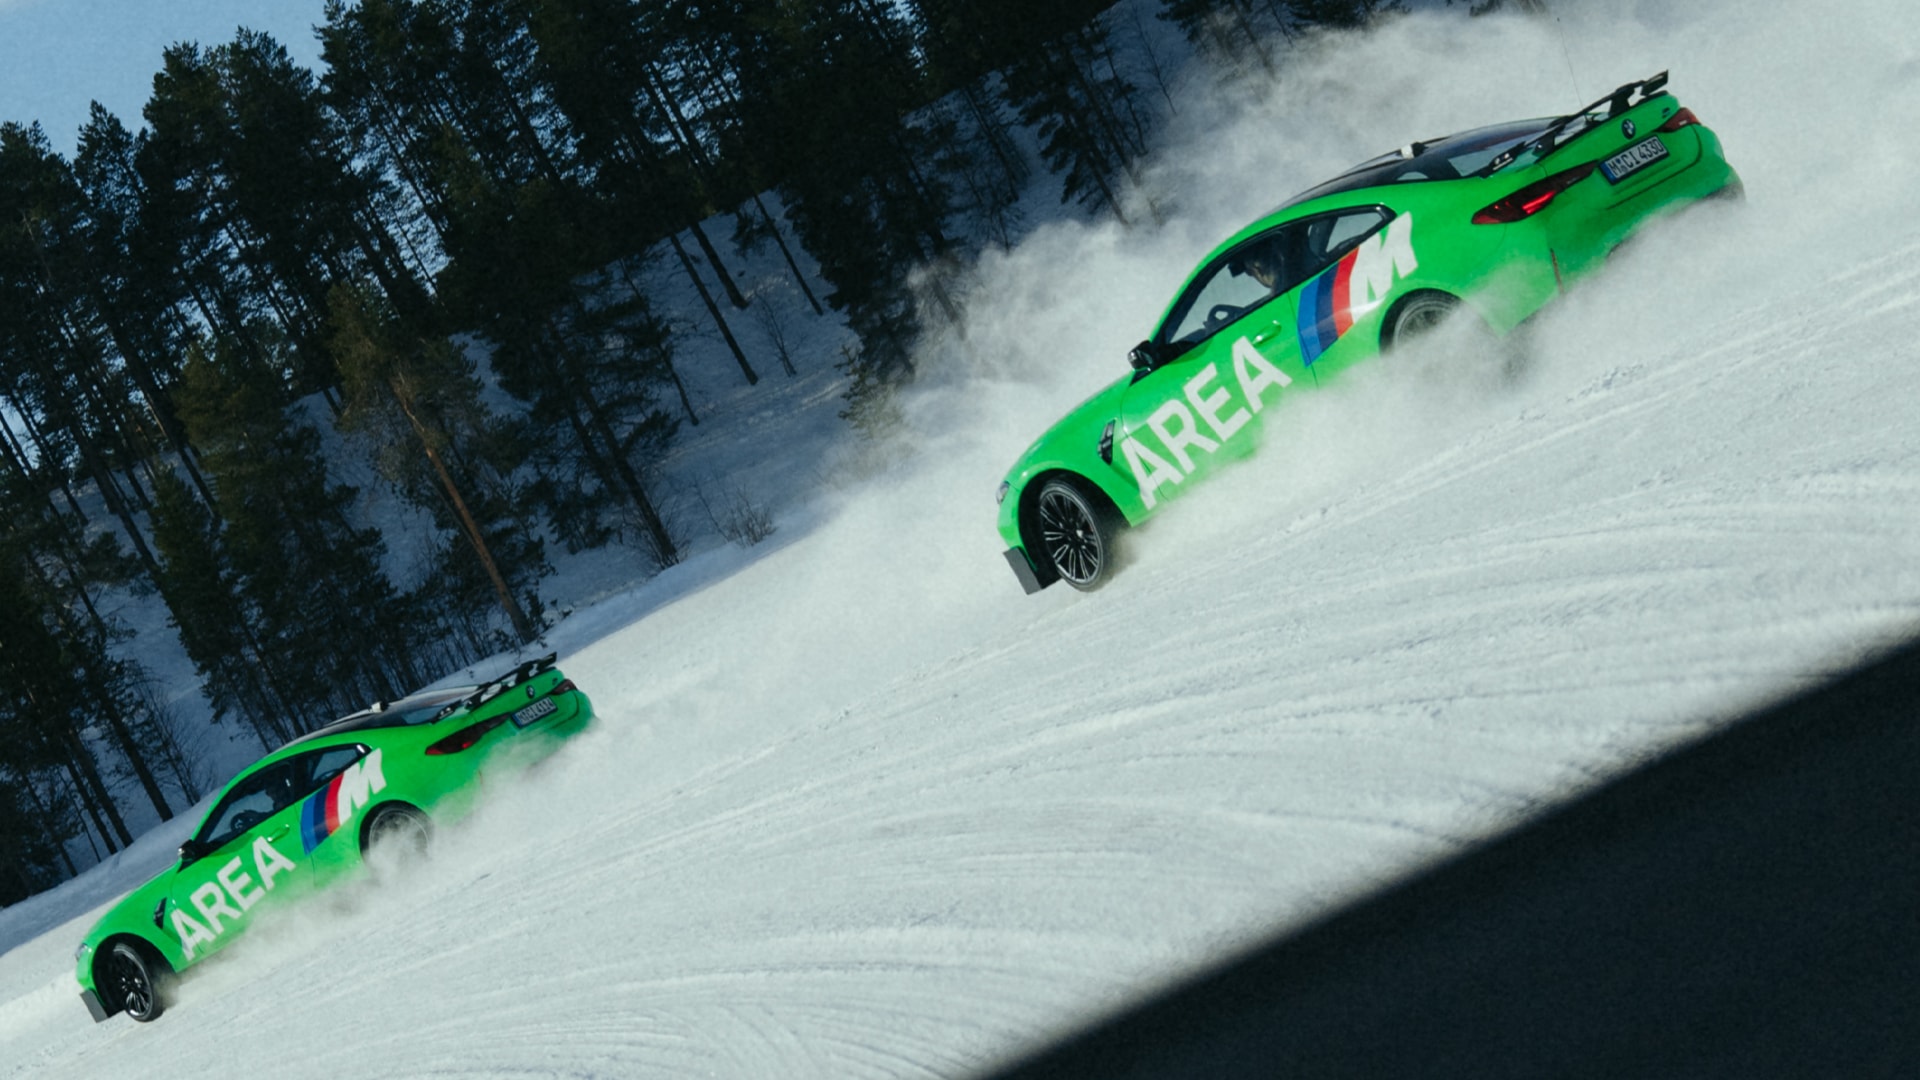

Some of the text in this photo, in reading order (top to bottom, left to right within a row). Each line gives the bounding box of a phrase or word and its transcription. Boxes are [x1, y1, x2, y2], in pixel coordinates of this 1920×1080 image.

[1120, 210, 1419, 511] AREA M
[170, 748, 387, 961] AREA M
